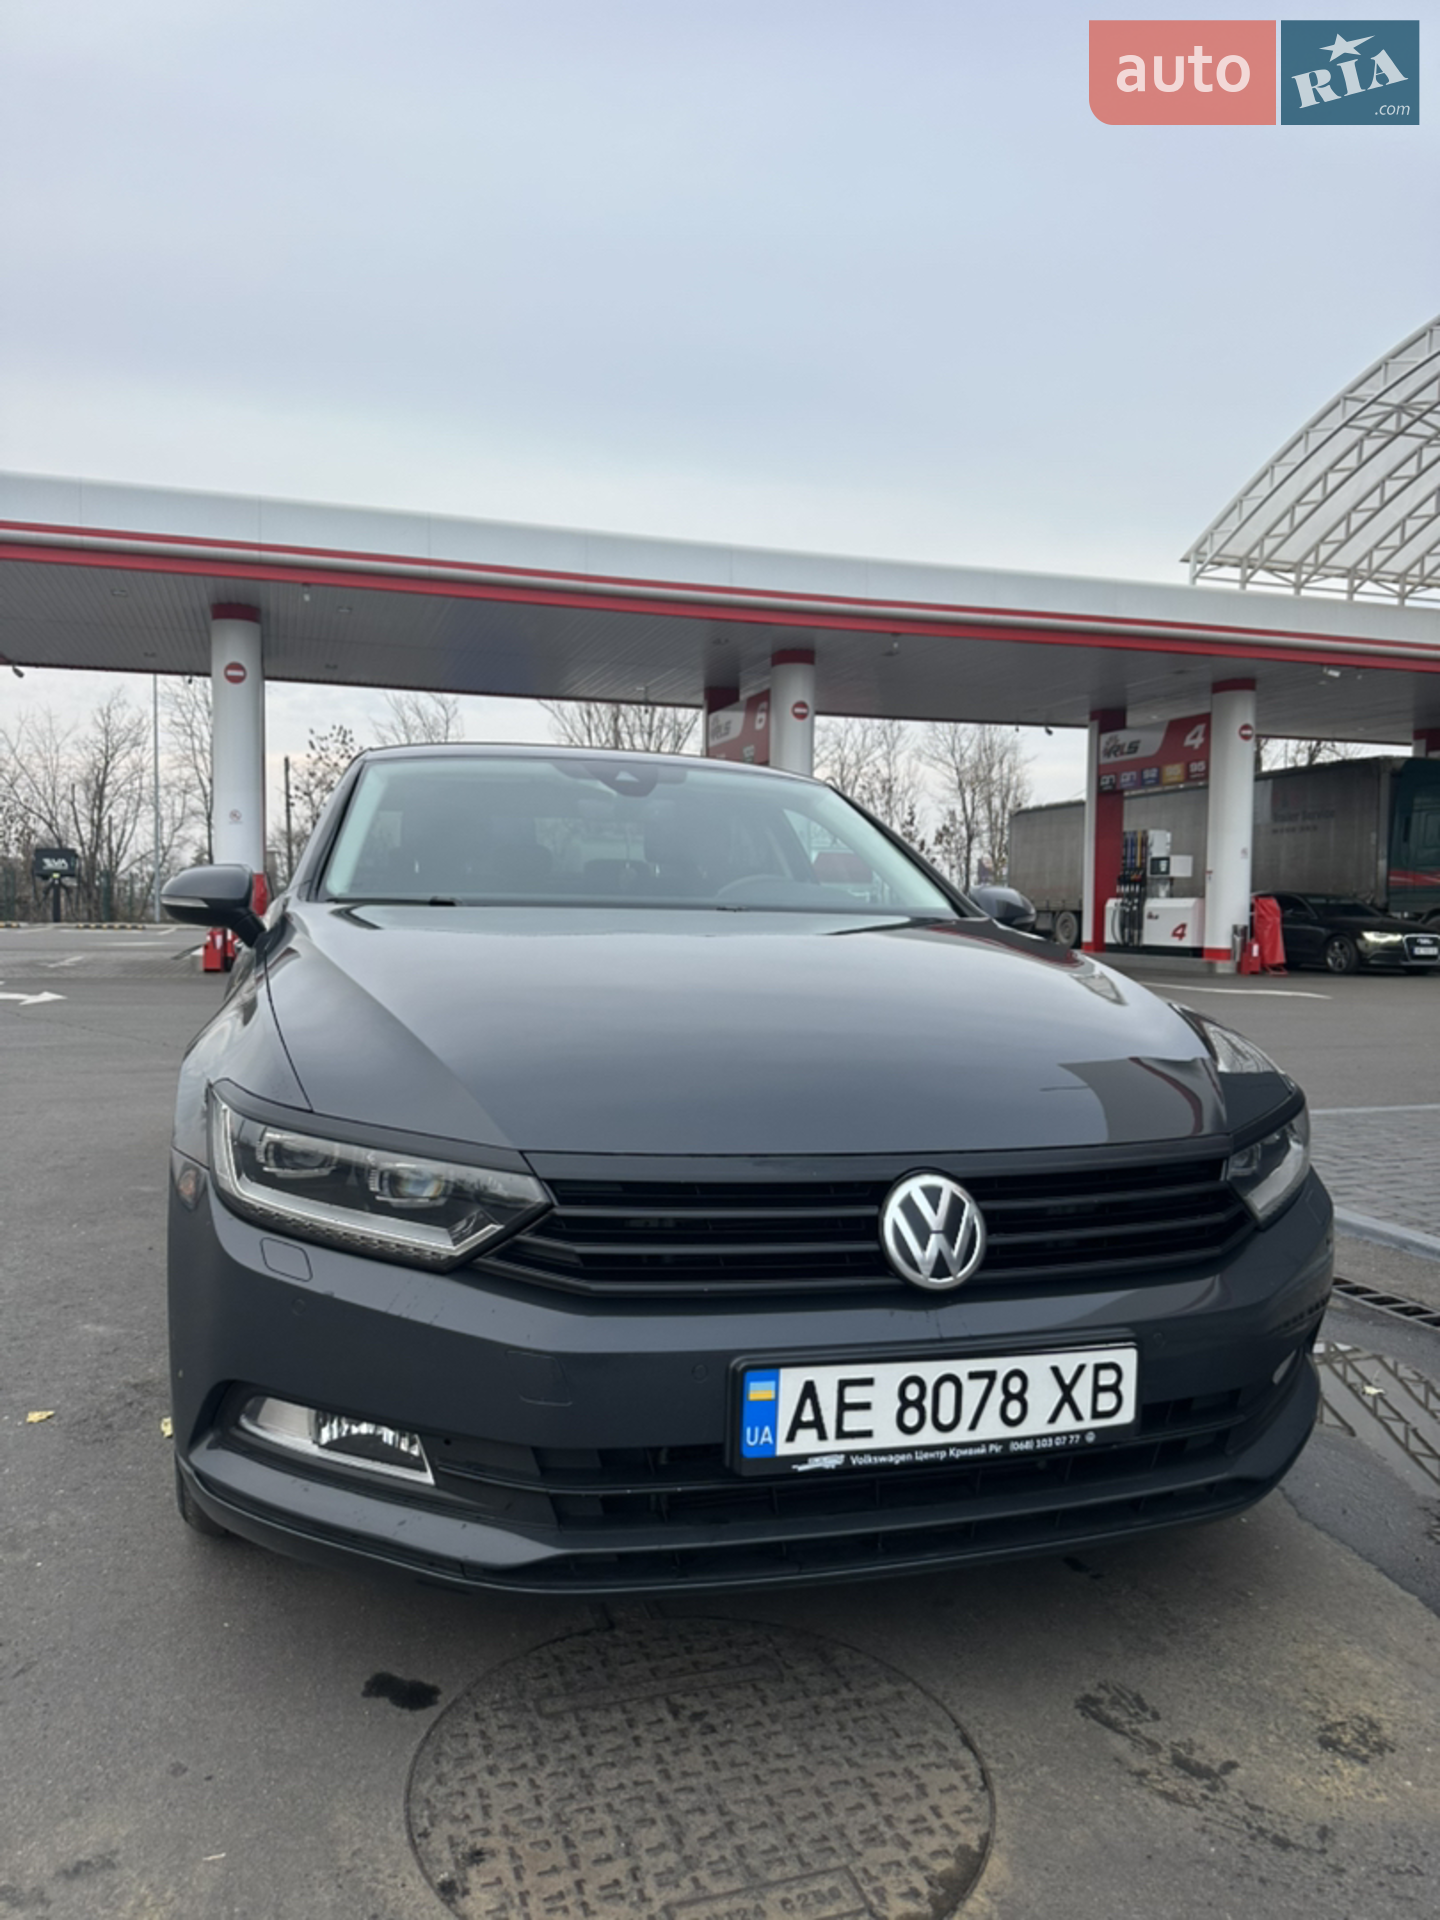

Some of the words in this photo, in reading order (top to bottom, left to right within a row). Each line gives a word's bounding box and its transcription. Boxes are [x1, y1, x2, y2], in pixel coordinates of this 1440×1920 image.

[1183, 723, 1206, 750] 4
[1171, 923, 1188, 941] 4
[783, 1377, 876, 1443] AE
[895, 1369, 1029, 1435] 8078
[1047, 1361, 1124, 1424] XB
[745, 1425, 774, 1447] UA
[850, 1452, 912, 1465] Volkswagen
